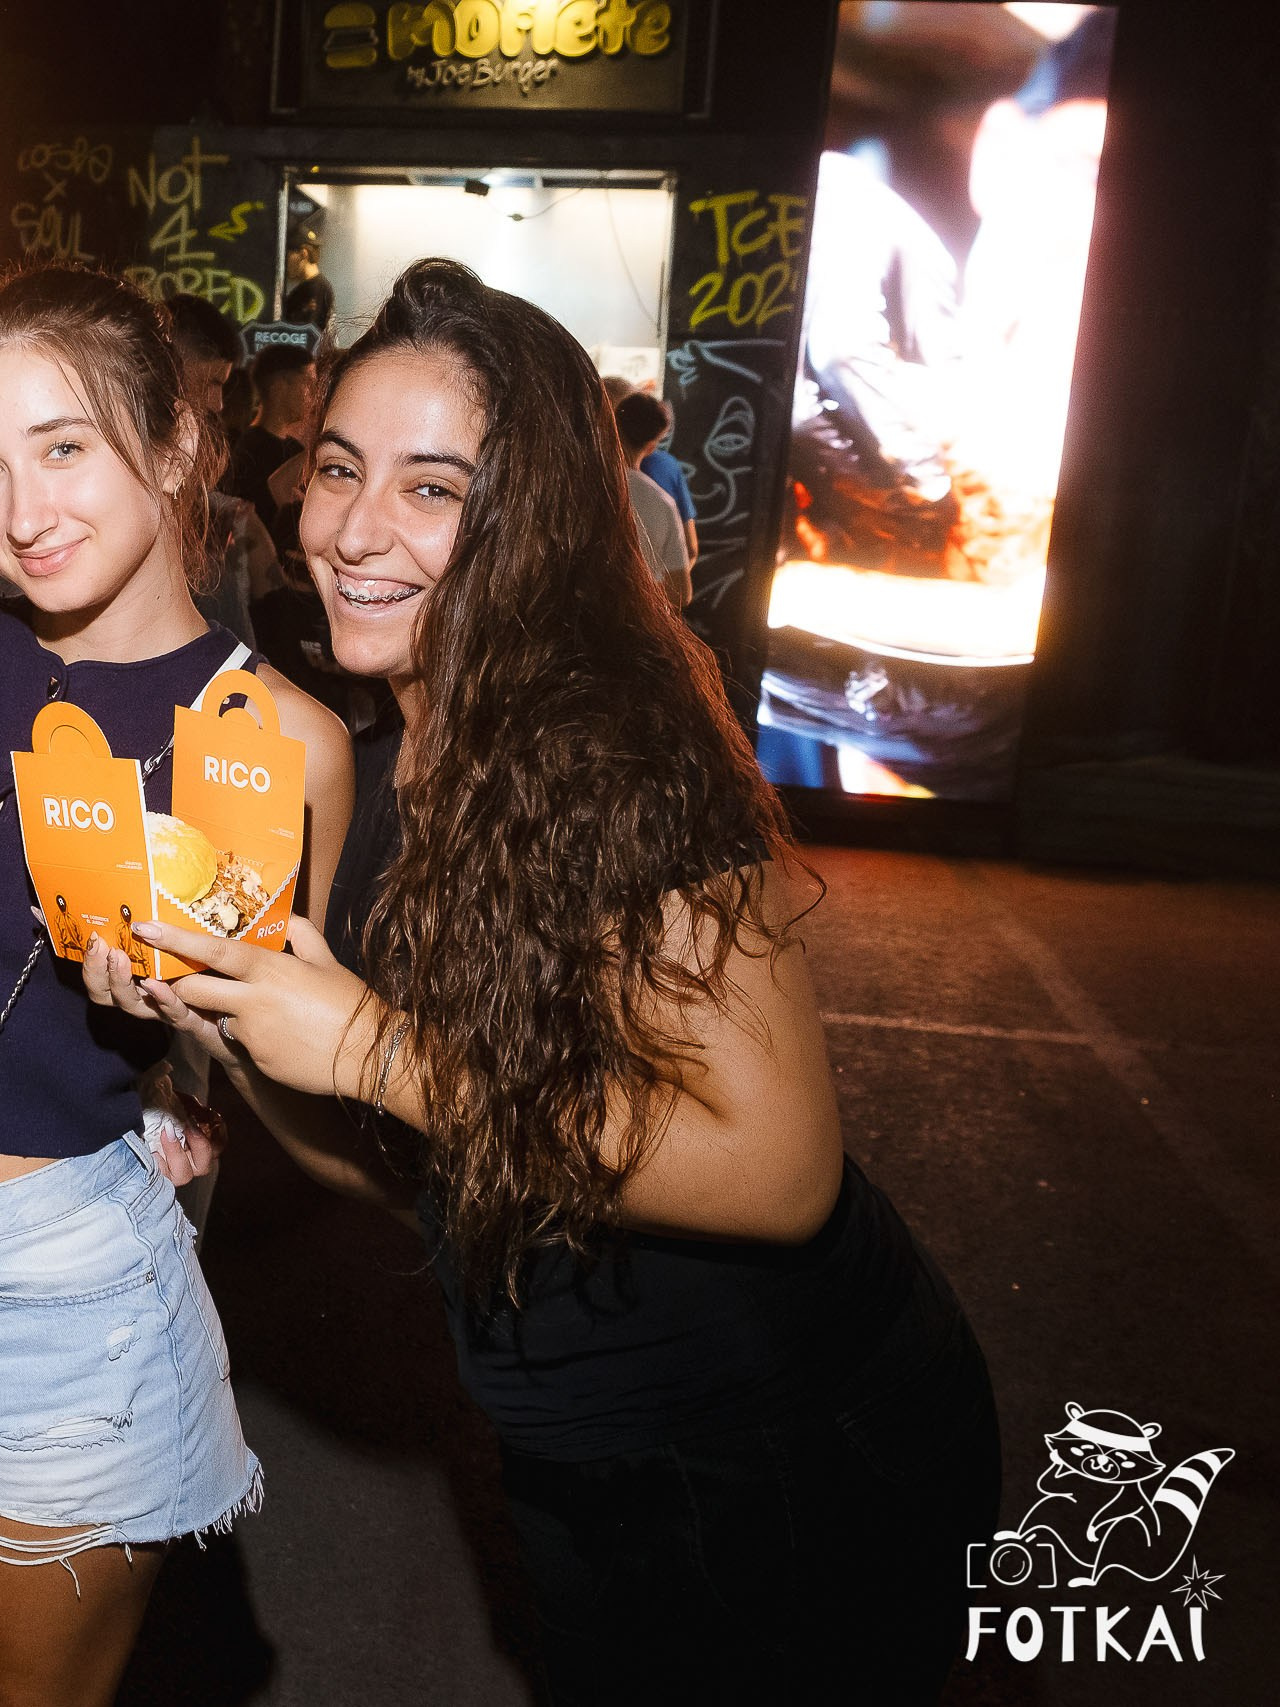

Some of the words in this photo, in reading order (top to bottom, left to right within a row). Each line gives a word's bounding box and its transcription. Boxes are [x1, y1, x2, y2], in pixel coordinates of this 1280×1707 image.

[254, 331, 307, 345] RECOGE
[204, 756, 271, 793] RICO
[43, 797, 115, 831] RICO
[257, 921, 285, 939] RICO
